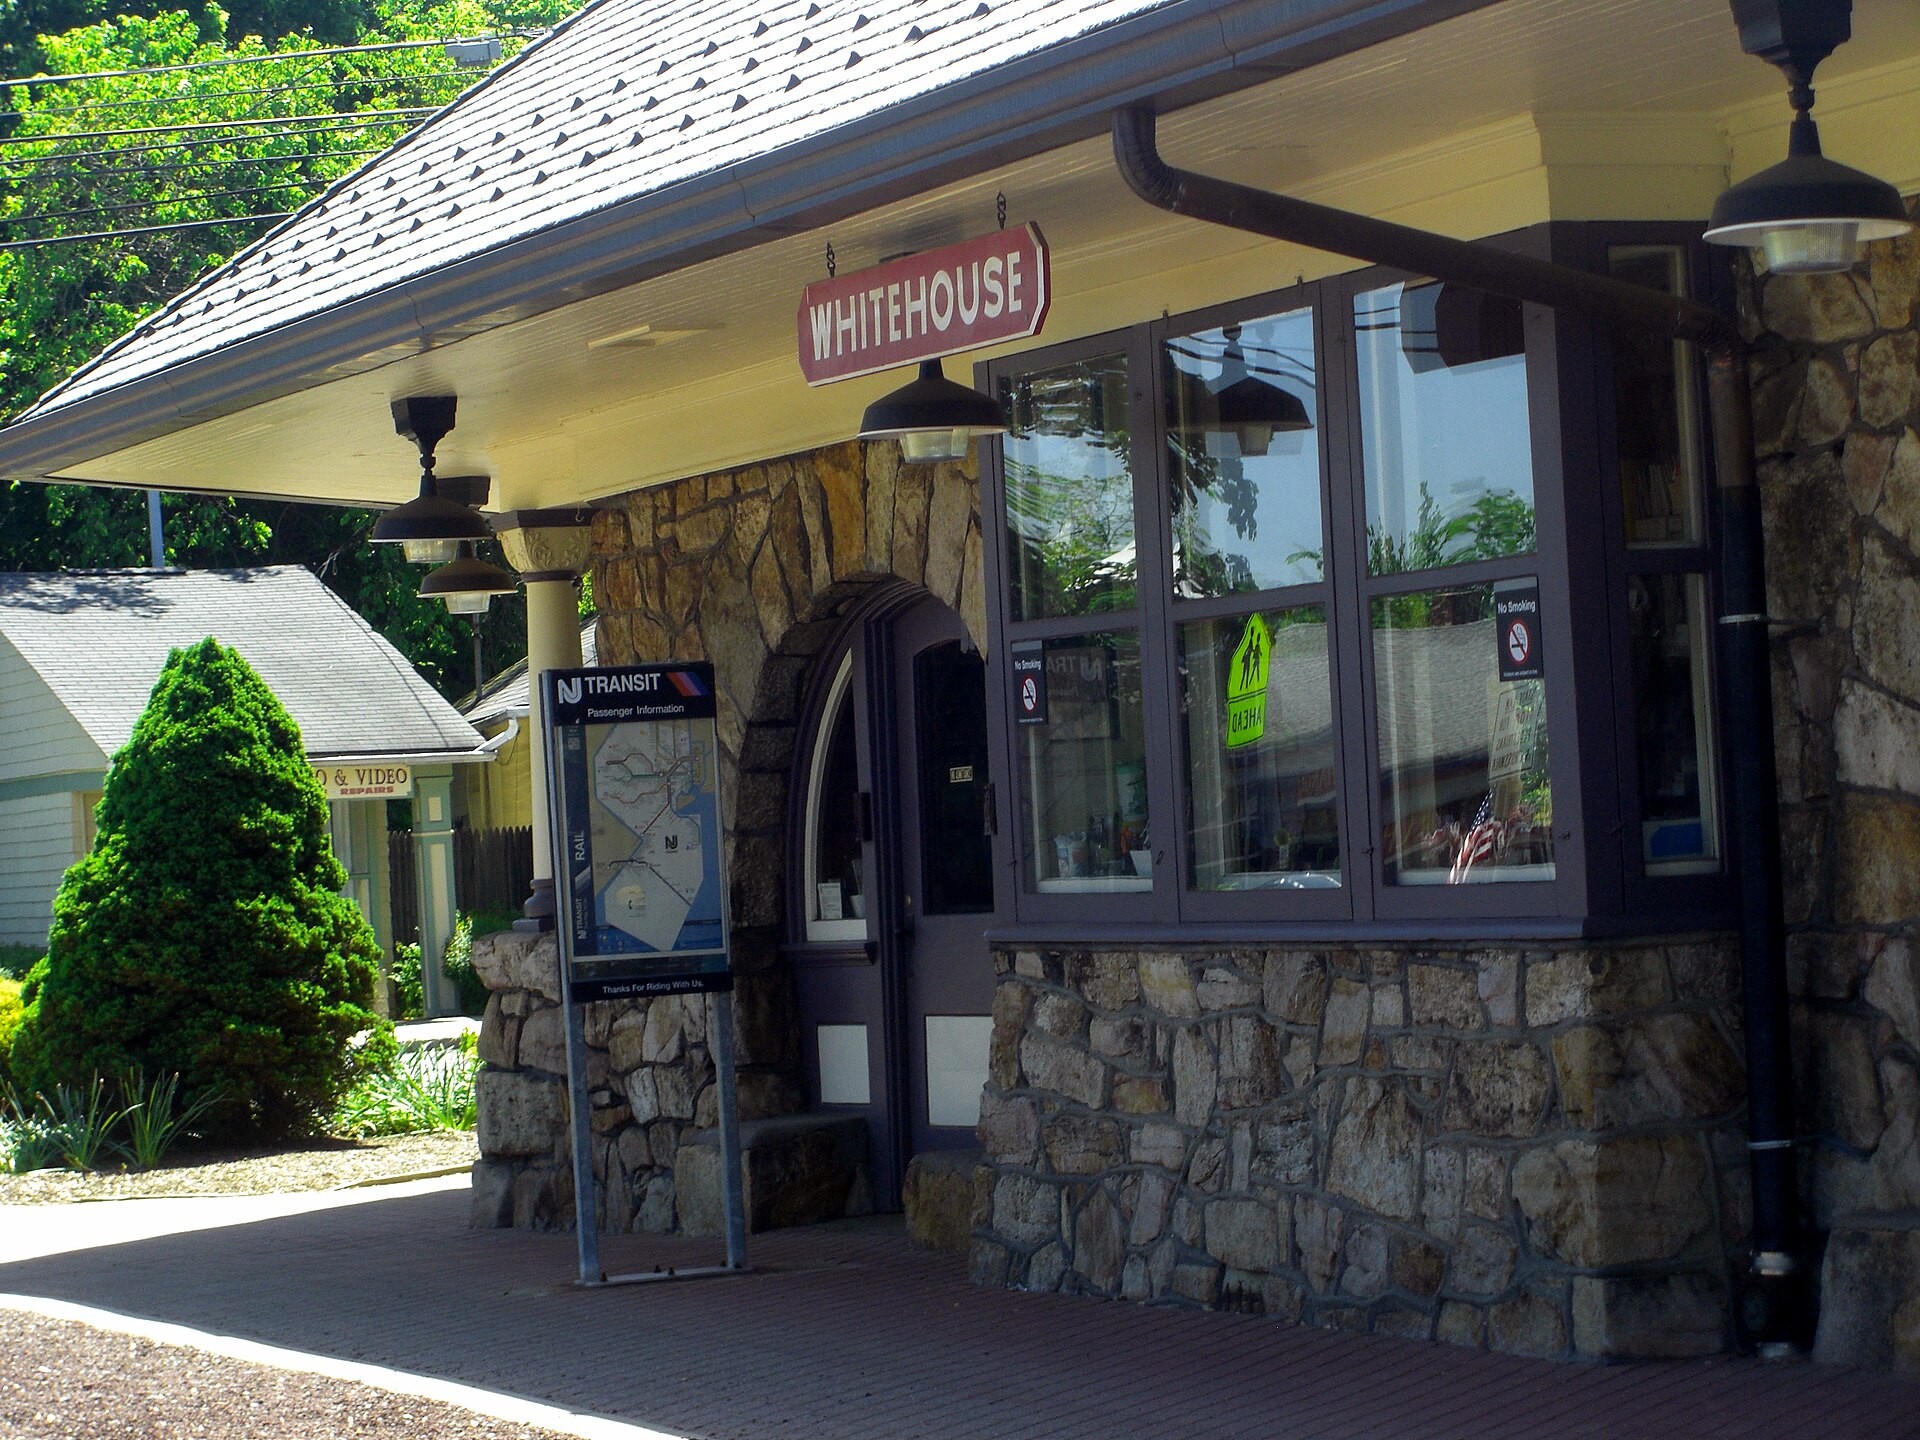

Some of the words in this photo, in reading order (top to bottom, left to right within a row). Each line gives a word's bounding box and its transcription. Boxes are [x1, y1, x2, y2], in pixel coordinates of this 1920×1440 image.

[809, 251, 1022, 361] WHITEHOUSE
[1497, 603, 1508, 614] No
[1508, 599, 1536, 614] Smoking
[1014, 660, 1022, 670] No
[1022, 659, 1042, 670] Smoking
[558, 677, 582, 704] NJ
[584, 673, 661, 694] TRANSIT
[587, 706, 633, 718] Passenger
[636, 704, 684, 715] Information
[334, 769, 348, 786] &
[354, 768, 408, 785] VIDEO
[340, 786, 394, 795] REPAIRS
[574, 829, 585, 861] RAIL
[575, 898, 584, 930] TRANSIT
[602, 985, 630, 994] Thanks
[632, 983, 645, 992] For
[646, 982, 671, 991] Riding
[672, 980, 690, 989] With
[691, 979, 704, 988] Us.
